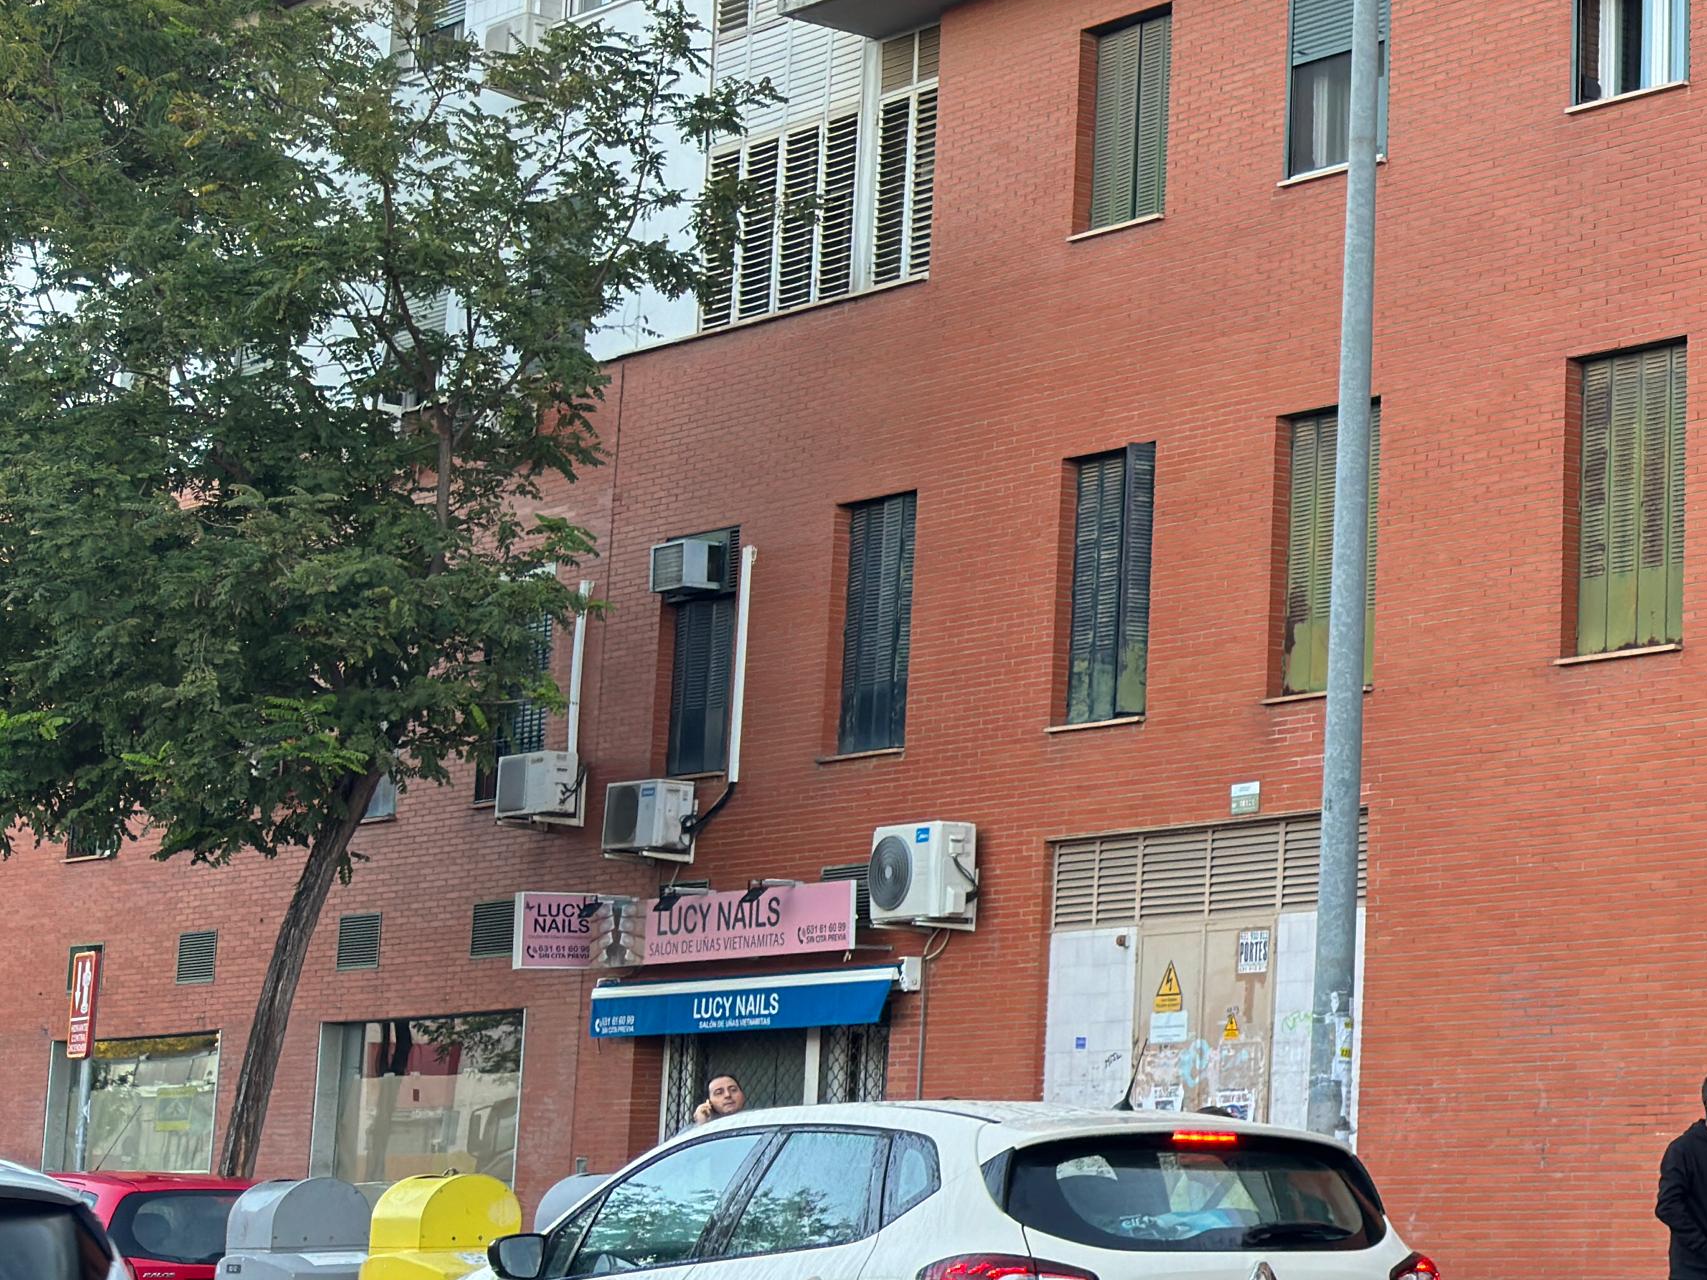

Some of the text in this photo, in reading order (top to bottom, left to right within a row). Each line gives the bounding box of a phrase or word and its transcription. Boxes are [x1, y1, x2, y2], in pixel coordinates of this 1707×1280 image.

[534, 919, 590, 933] NAILS
[657, 896, 781, 936] LUCY NAILS
[649, 933, 785, 956] SALÓN DE UÑAS VIETNAMITAS
[1240, 941, 1267, 963] PORTES
[693, 993, 779, 1019] LUCY NAILS
